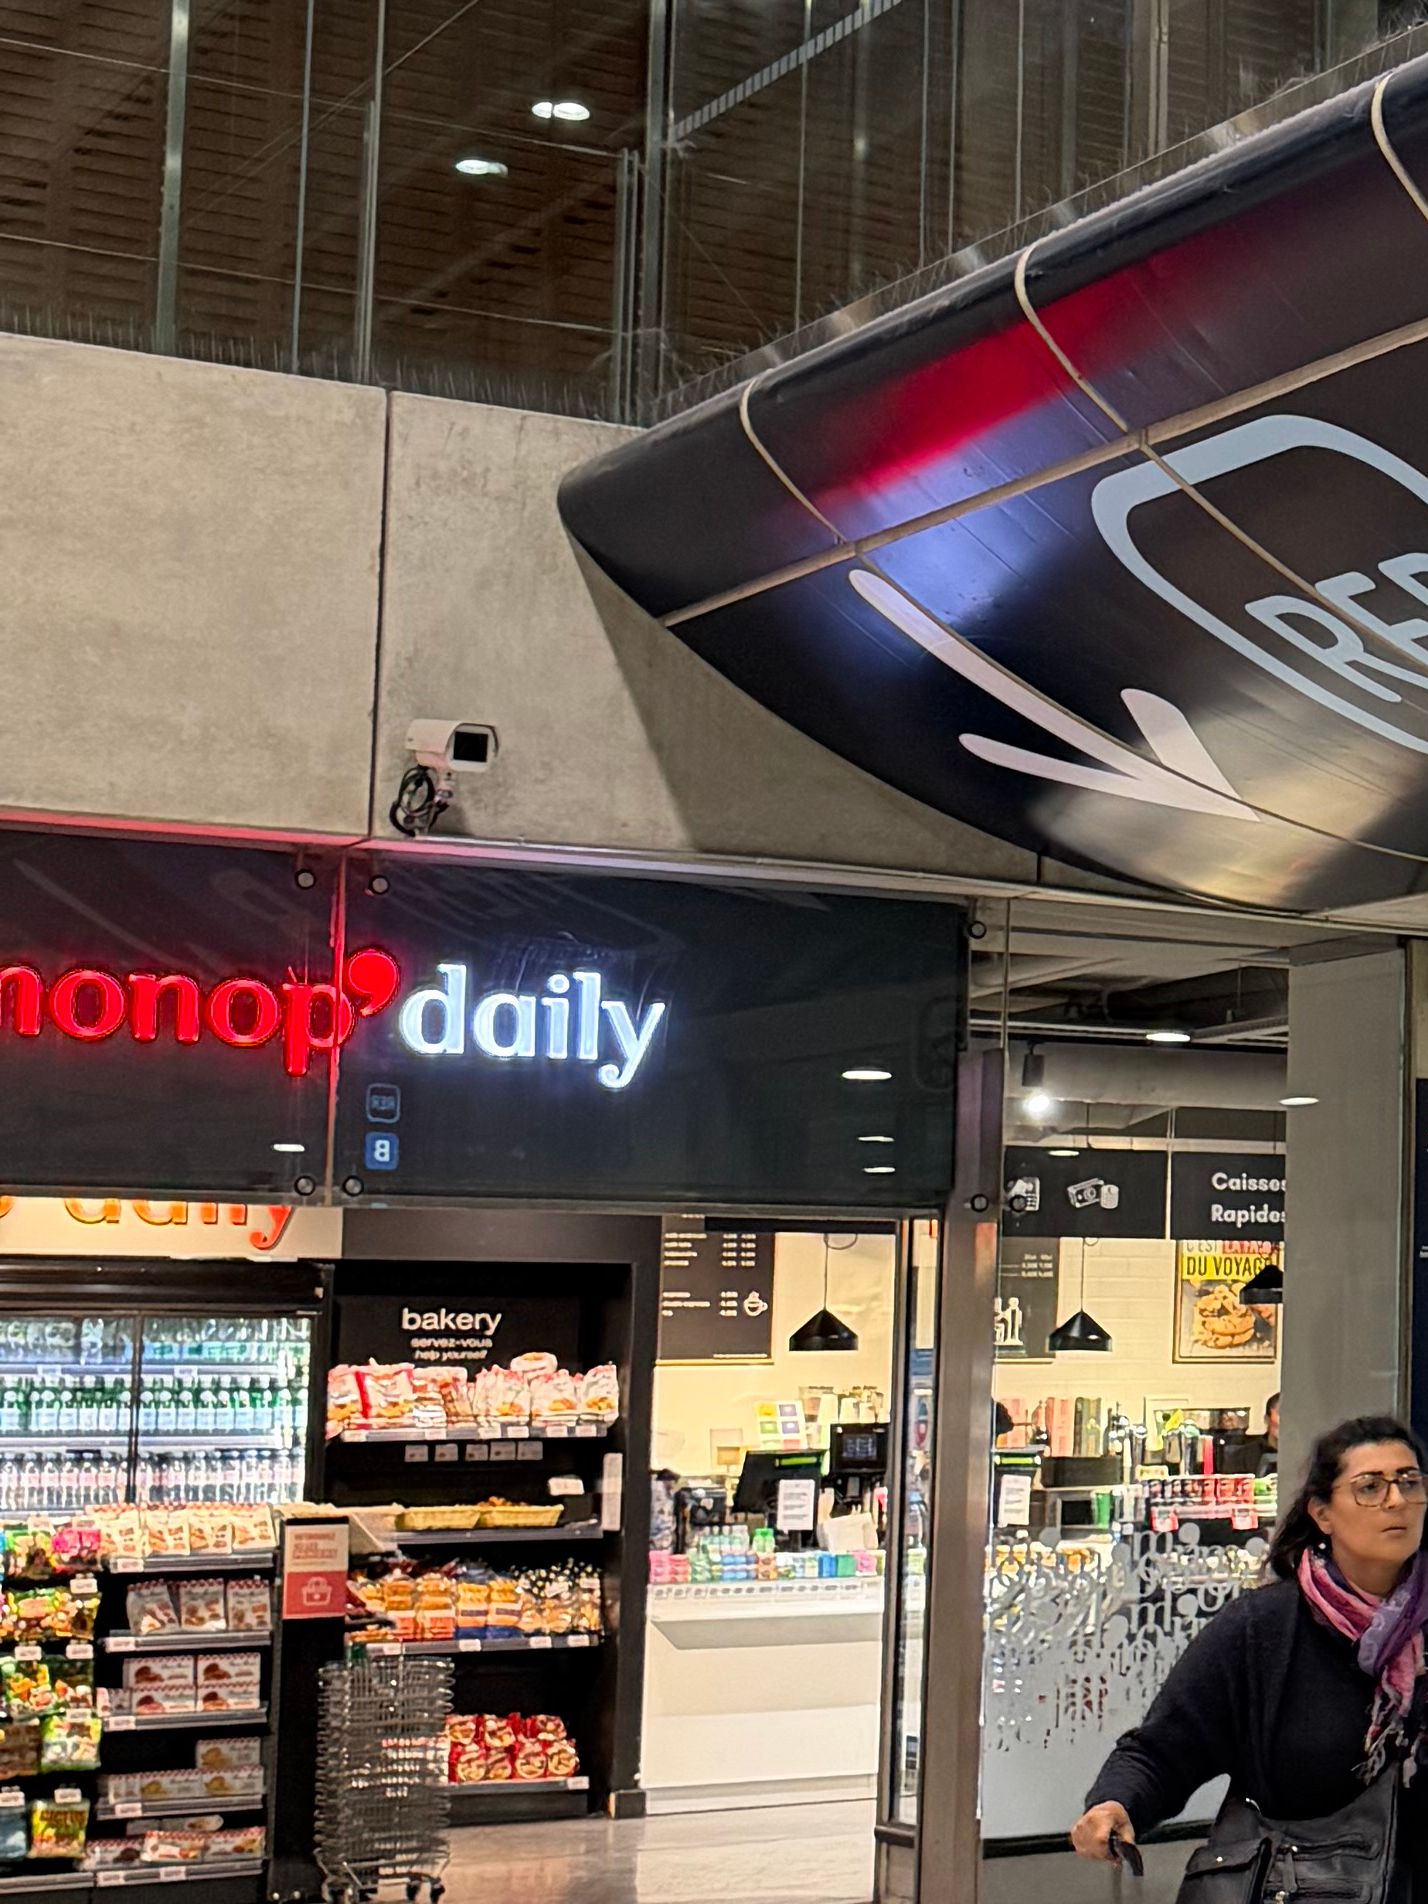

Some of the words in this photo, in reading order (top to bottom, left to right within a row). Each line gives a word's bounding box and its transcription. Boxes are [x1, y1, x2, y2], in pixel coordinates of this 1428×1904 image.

[400, 963, 666, 1089] daily
[1187, 1255, 1207, 1276] DU
[1213, 1255, 1263, 1277] VOYAG
[401, 1307, 502, 1336] bakery
[410, 1337, 493, 1348] servez-vous
[414, 1349, 441, 1361] help
